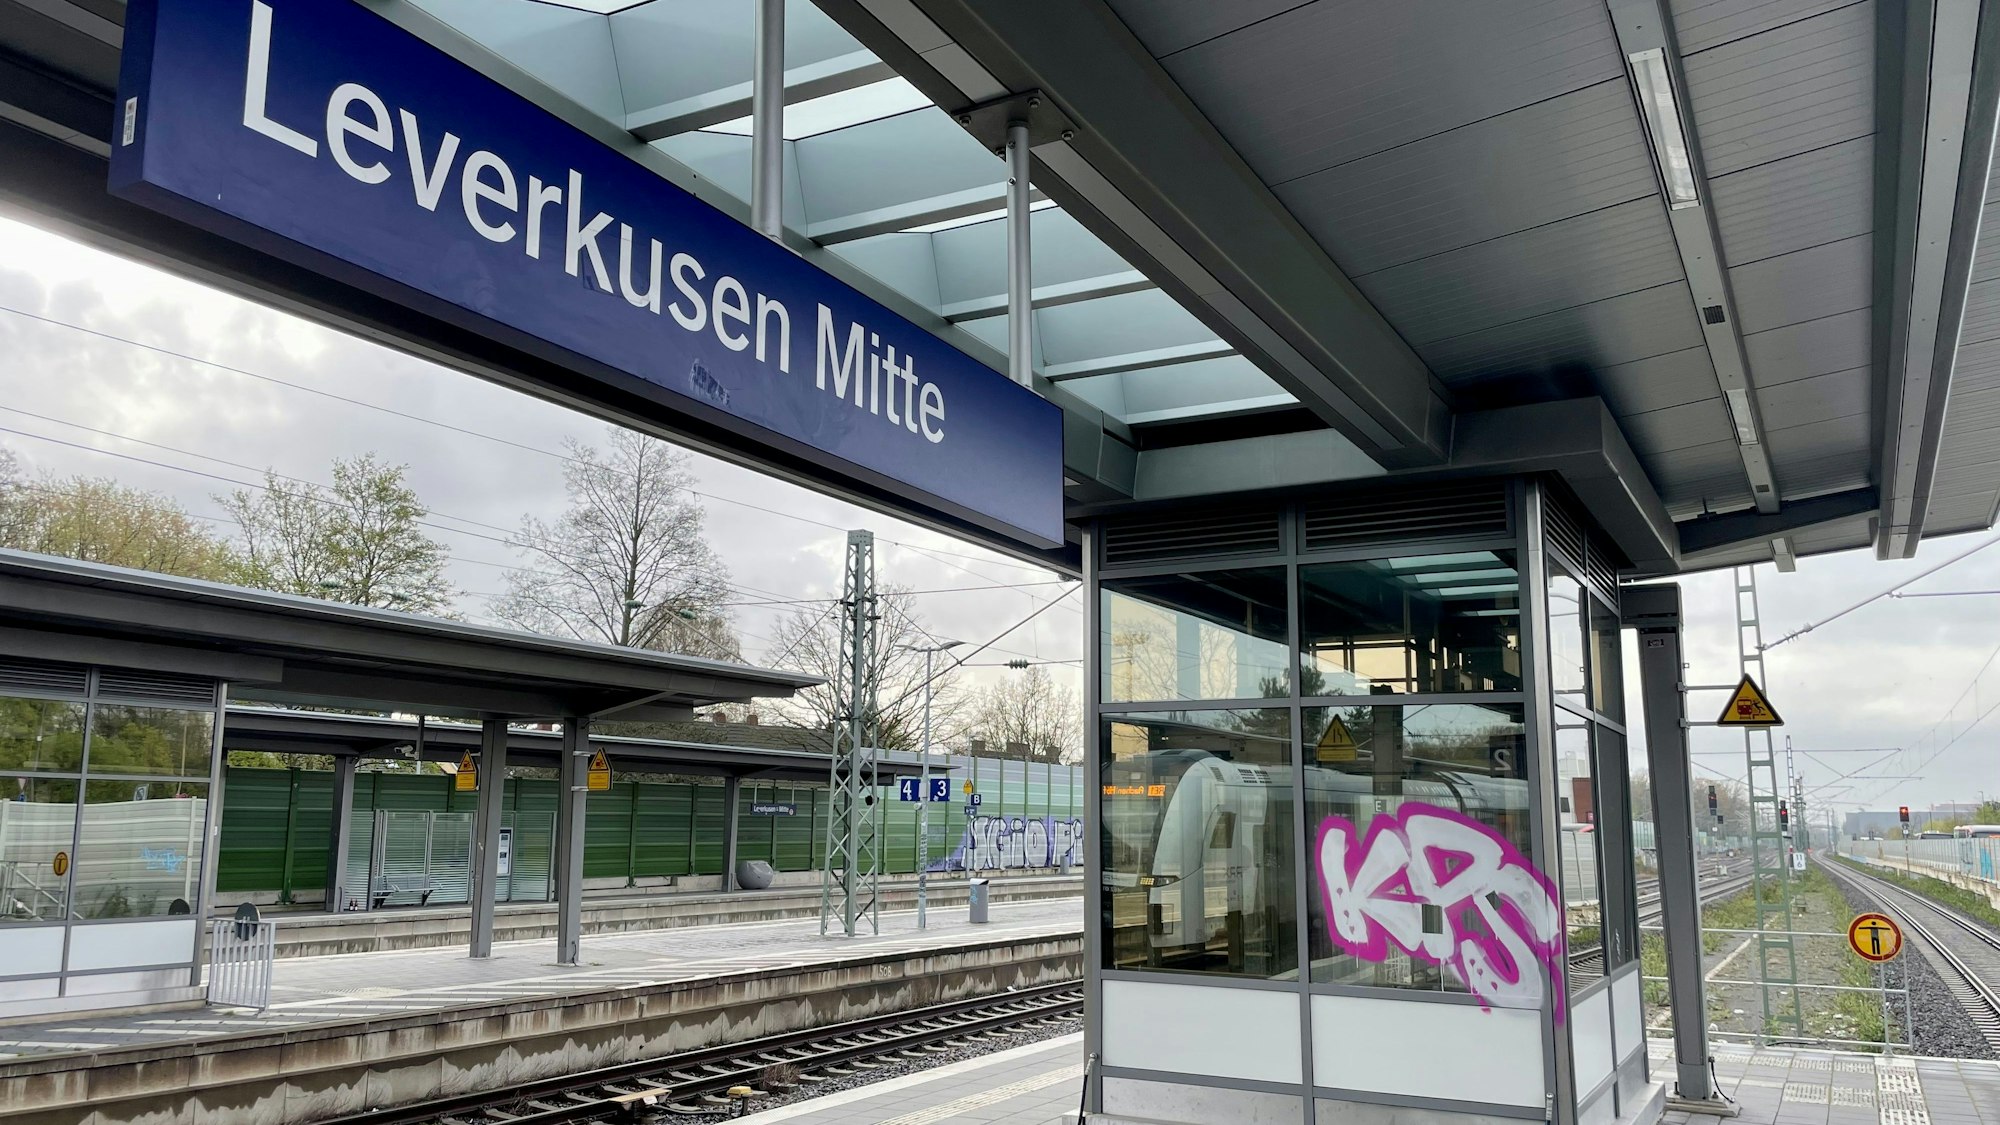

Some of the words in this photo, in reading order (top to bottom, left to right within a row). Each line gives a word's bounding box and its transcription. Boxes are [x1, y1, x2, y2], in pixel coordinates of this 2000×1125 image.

[242, 0, 791, 374] Leverkusen
[816, 302, 945, 444] Mitte
[902, 780, 912, 796] 4
[937, 780, 947, 797] 3
[973, 795, 980, 804] B
